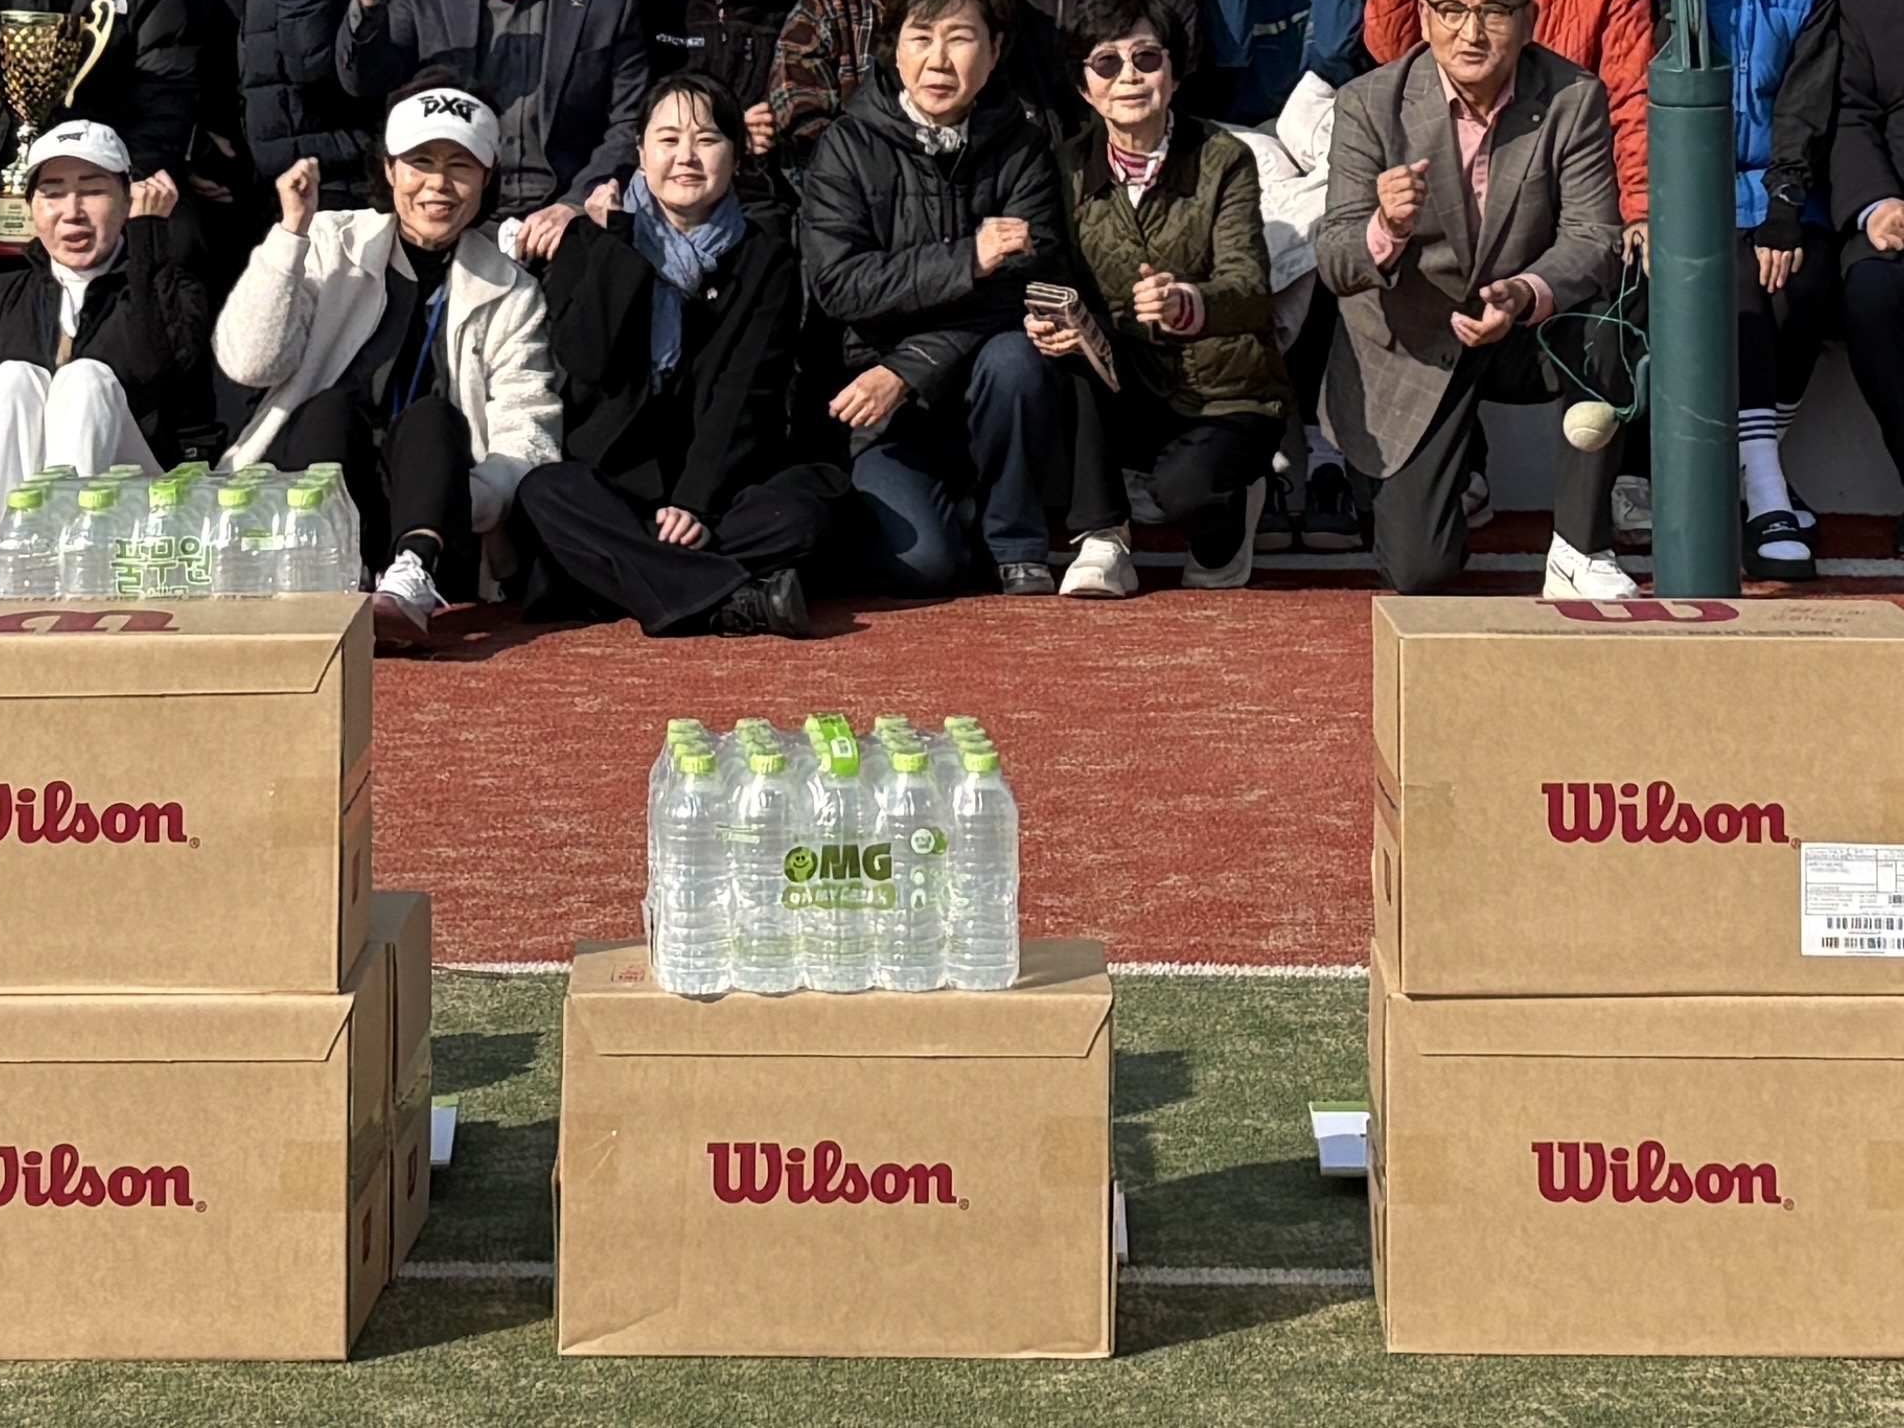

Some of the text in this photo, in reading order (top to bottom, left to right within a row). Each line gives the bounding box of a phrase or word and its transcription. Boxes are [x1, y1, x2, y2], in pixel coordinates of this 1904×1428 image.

[110, 536, 212, 595] 풀무원
[1542, 782, 1789, 845] Wilson
[708, 1141, 958, 1205] Wilson
[1533, 1140, 1782, 1205] Wilson
